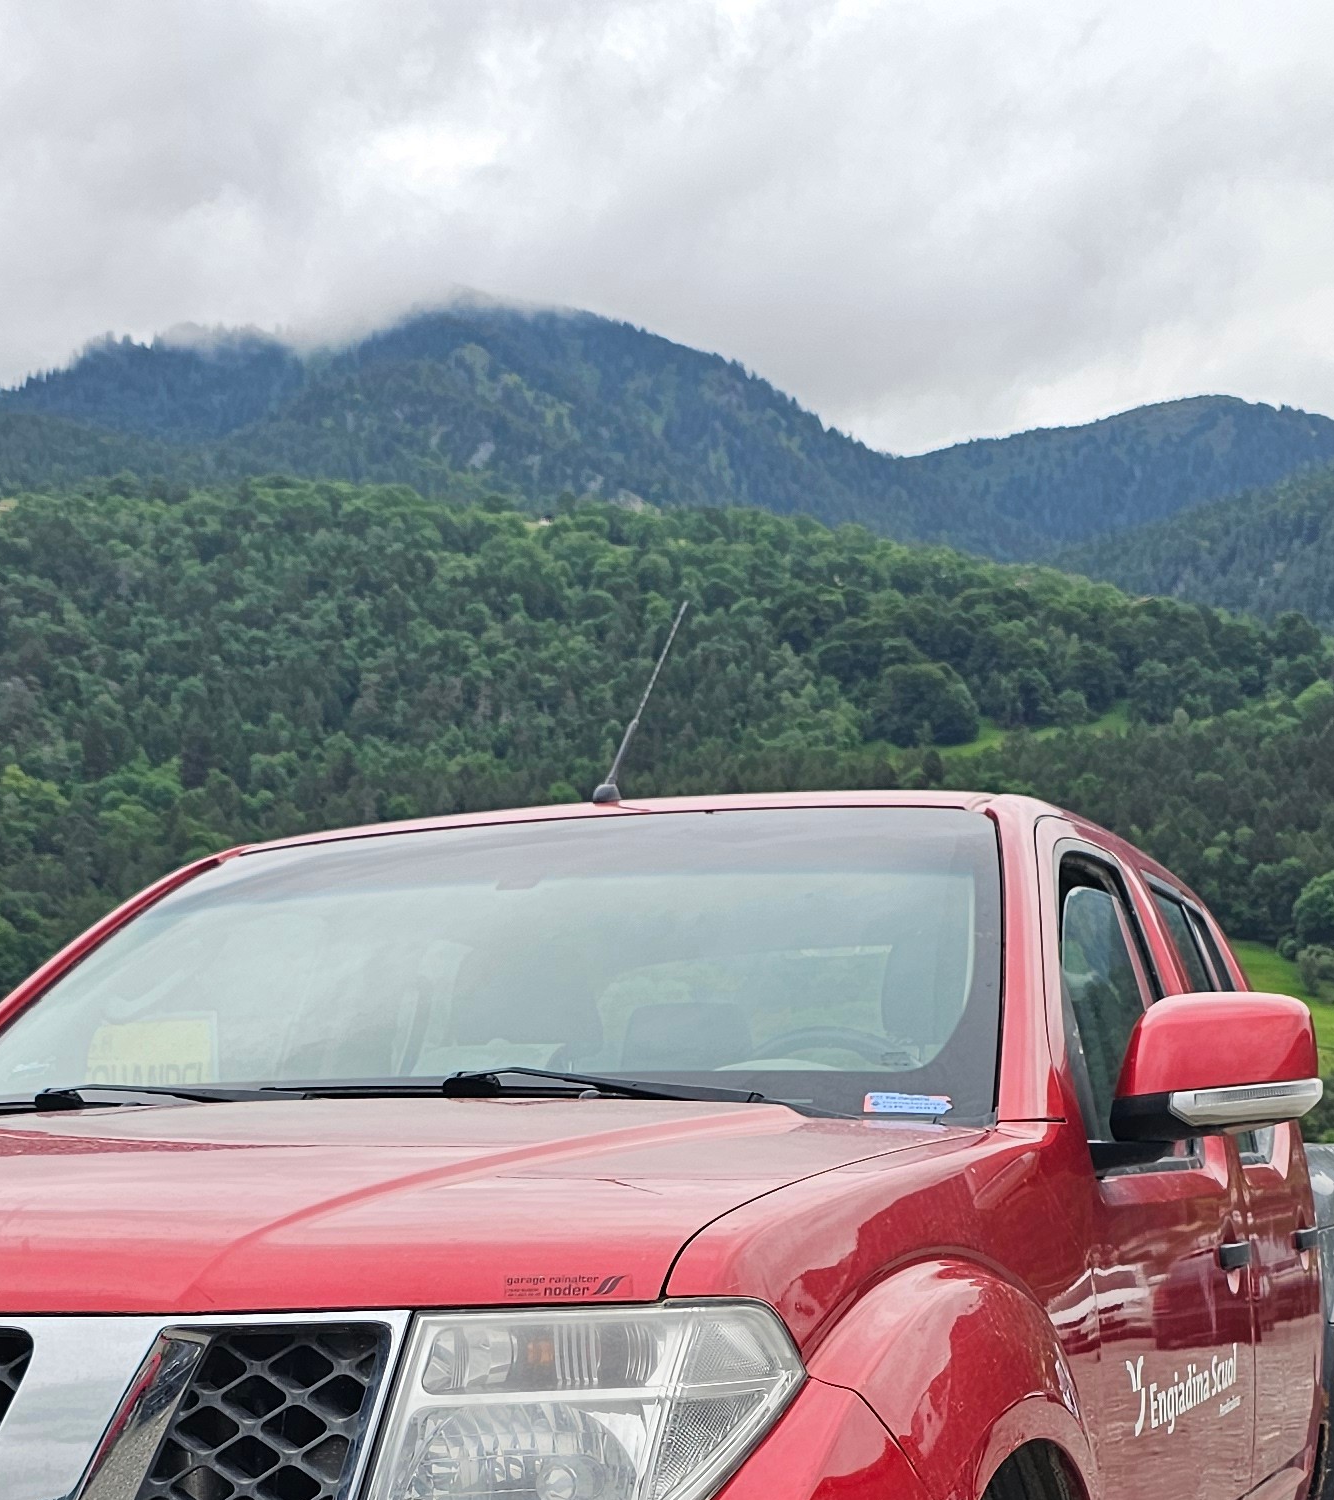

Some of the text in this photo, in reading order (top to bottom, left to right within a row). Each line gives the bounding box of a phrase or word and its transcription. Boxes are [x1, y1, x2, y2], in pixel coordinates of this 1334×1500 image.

[506, 1275, 546, 1286] garage
[543, 1284, 591, 1297] noder
[1150, 1342, 1238, 1435] Engiadina Scuol
